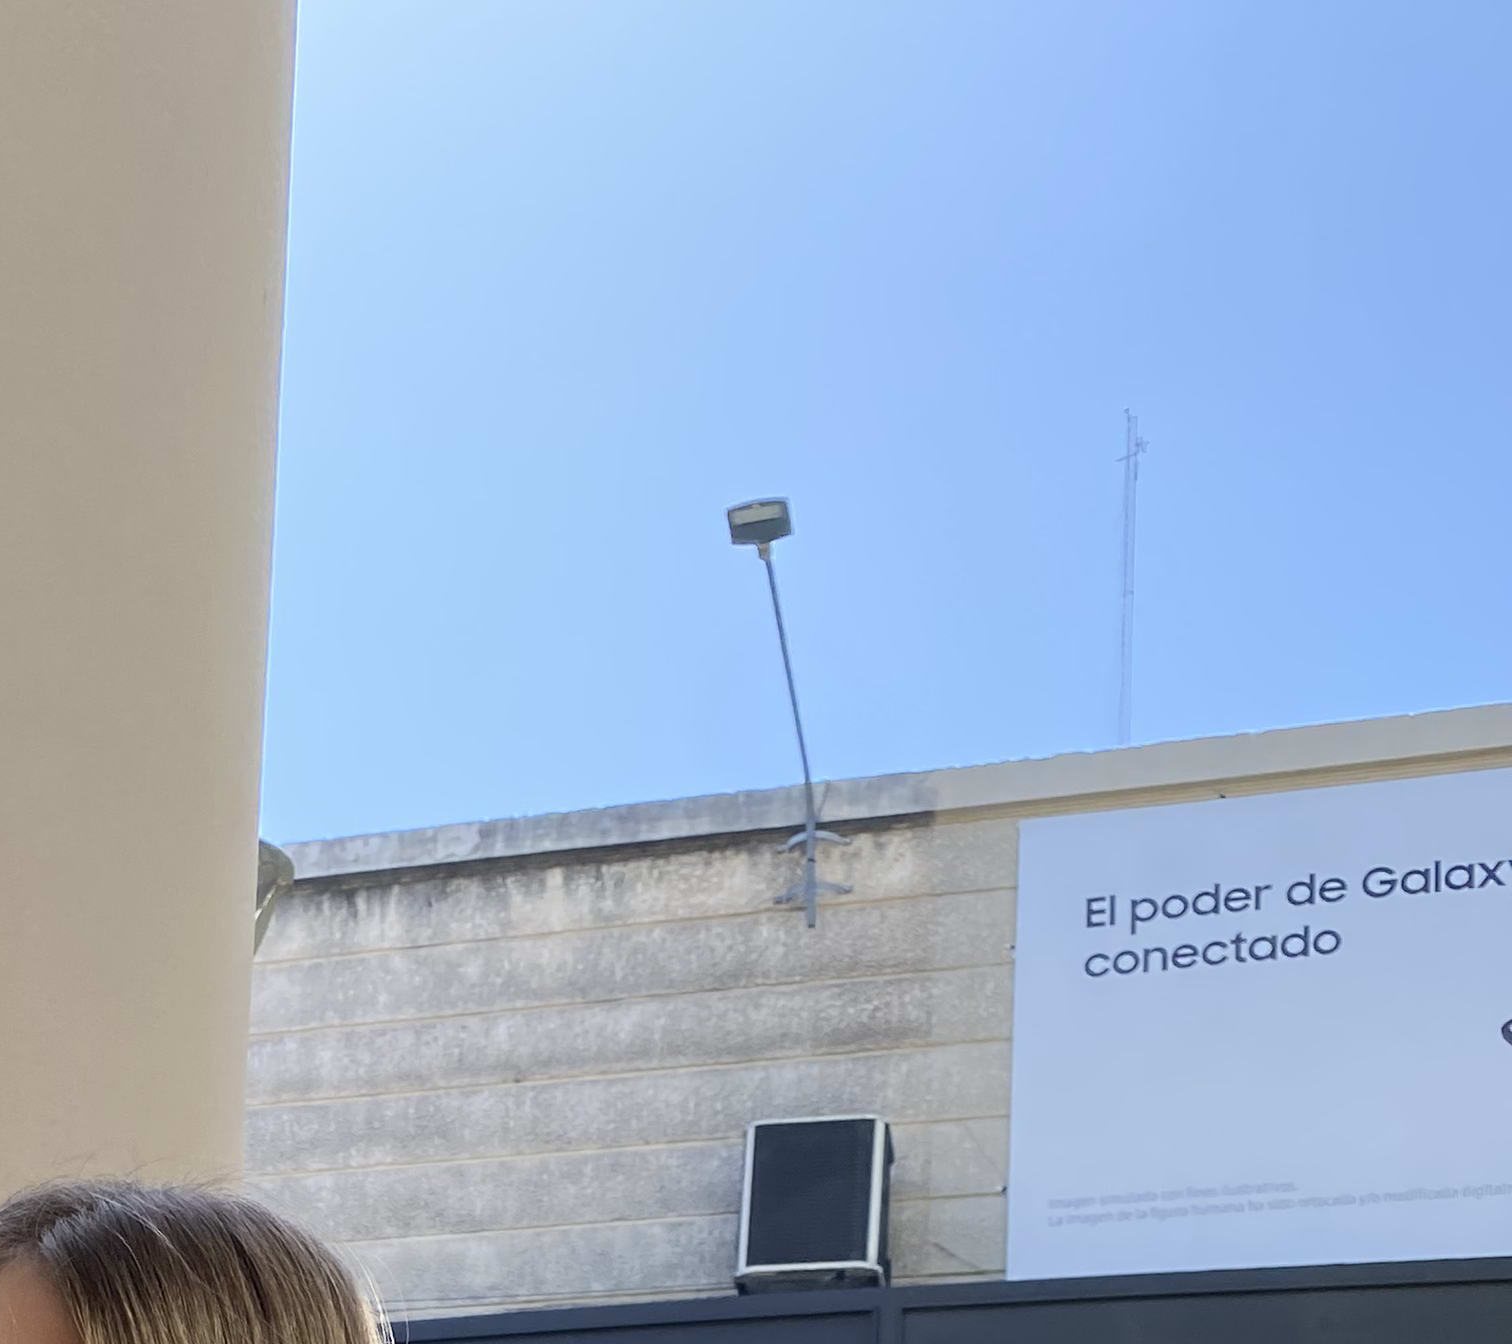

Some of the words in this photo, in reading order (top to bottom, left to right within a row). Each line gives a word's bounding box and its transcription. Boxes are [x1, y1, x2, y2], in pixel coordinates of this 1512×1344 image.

[1086, 895, 1116, 928] El
[1131, 883, 1273, 935] poder
[1287, 873, 1348, 906] de
[1362, 860, 1512, 898] Galax
[1085, 925, 1342, 977] conectado
